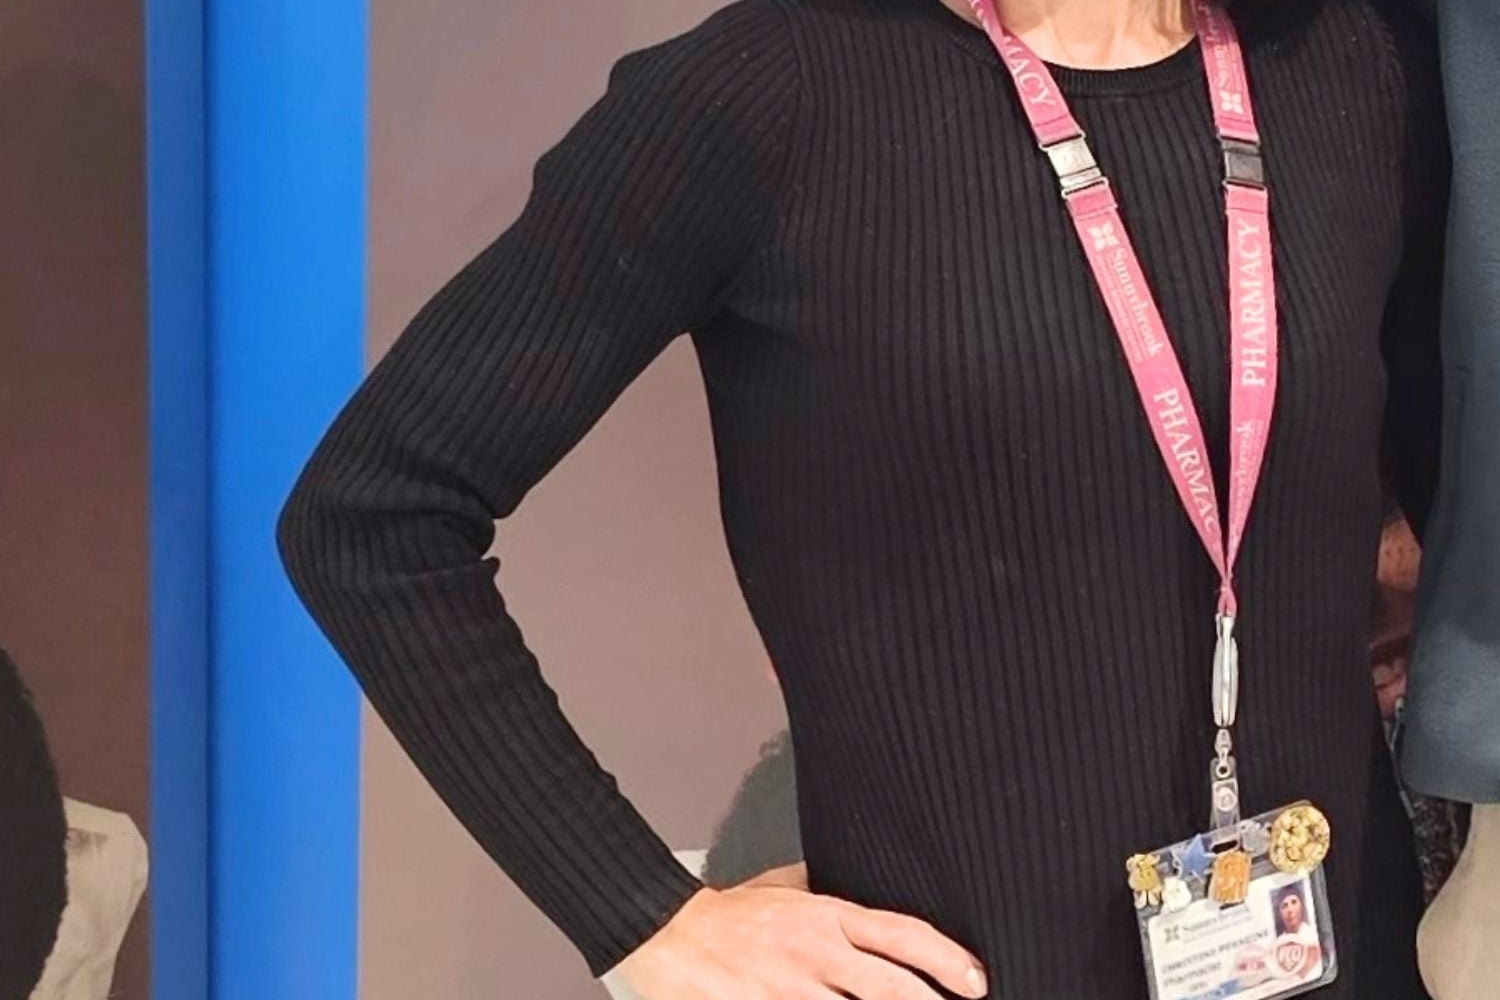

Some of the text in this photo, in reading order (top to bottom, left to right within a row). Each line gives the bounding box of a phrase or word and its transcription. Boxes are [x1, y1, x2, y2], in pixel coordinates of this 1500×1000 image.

[1113, 247, 1165, 358] Sunnybrook
[1236, 217, 1268, 388] PHARMACY
[1152, 387, 1218, 536] PHARMAC
